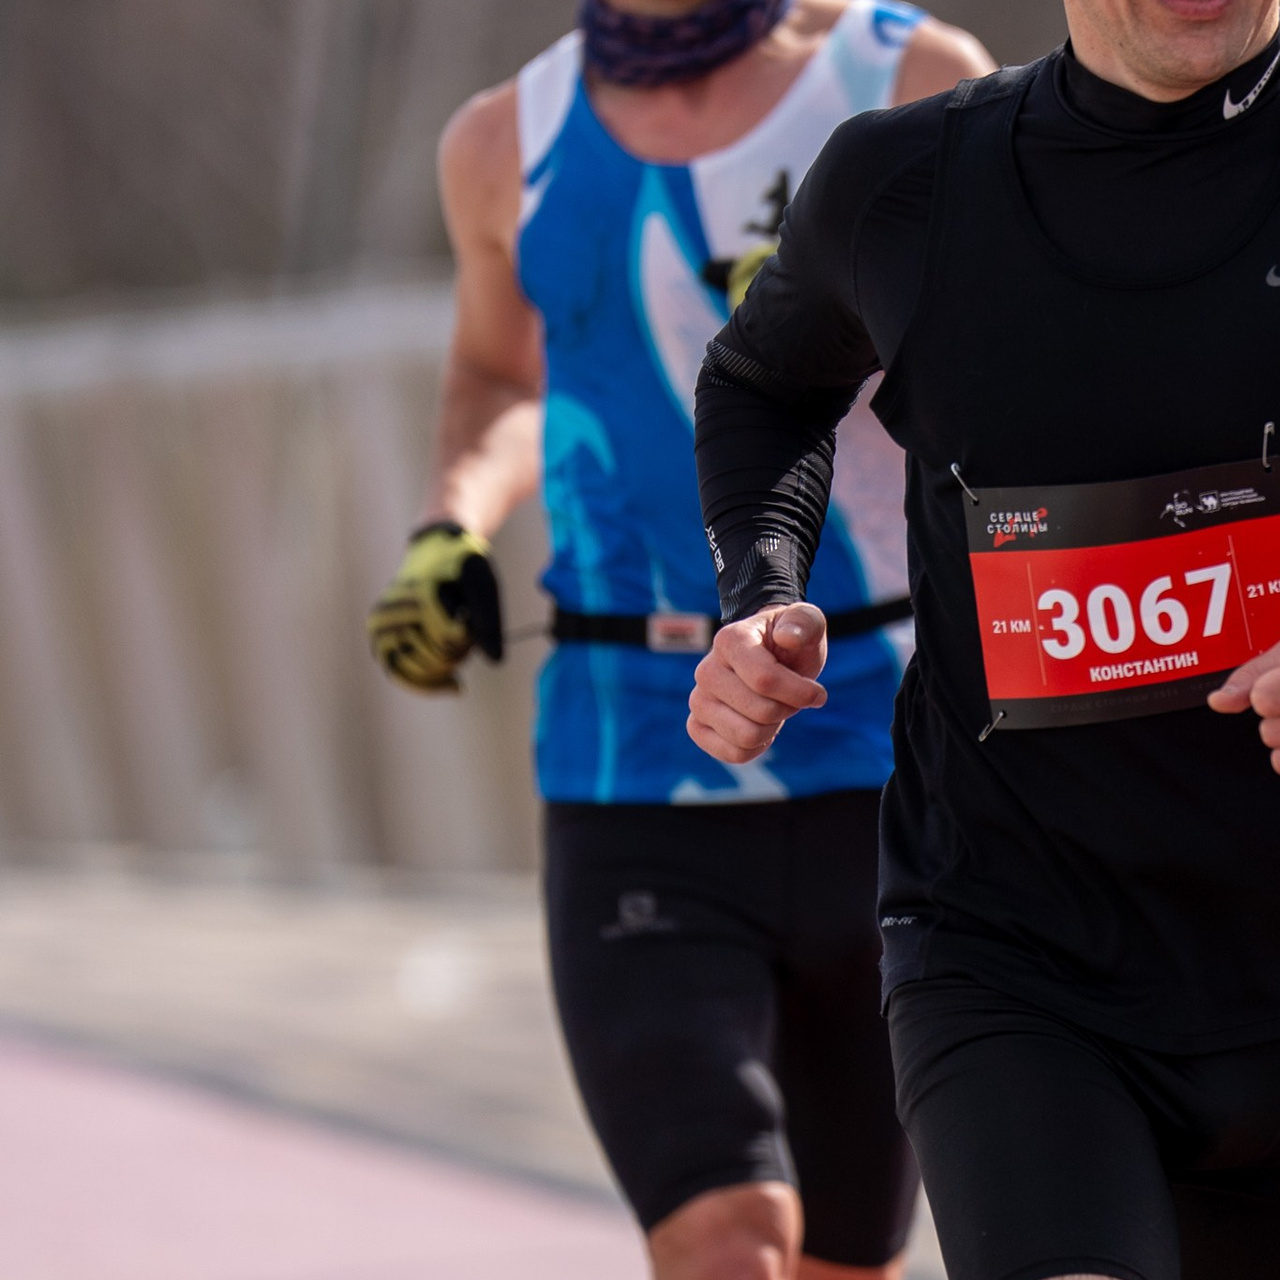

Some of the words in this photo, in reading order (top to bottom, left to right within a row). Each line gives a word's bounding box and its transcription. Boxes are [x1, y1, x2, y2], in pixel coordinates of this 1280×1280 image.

[989, 511, 1039, 523] СЕРДЦЕ
[986, 522, 1049, 535] СТОЛИЦЫ
[1246, 583, 1265, 599] 21
[1037, 562, 1232, 660] 3067
[992, 621, 1008, 634] 21
[1010, 620, 1032, 633] КМ
[1089, 651, 1199, 683] КОНСТАНТИН
